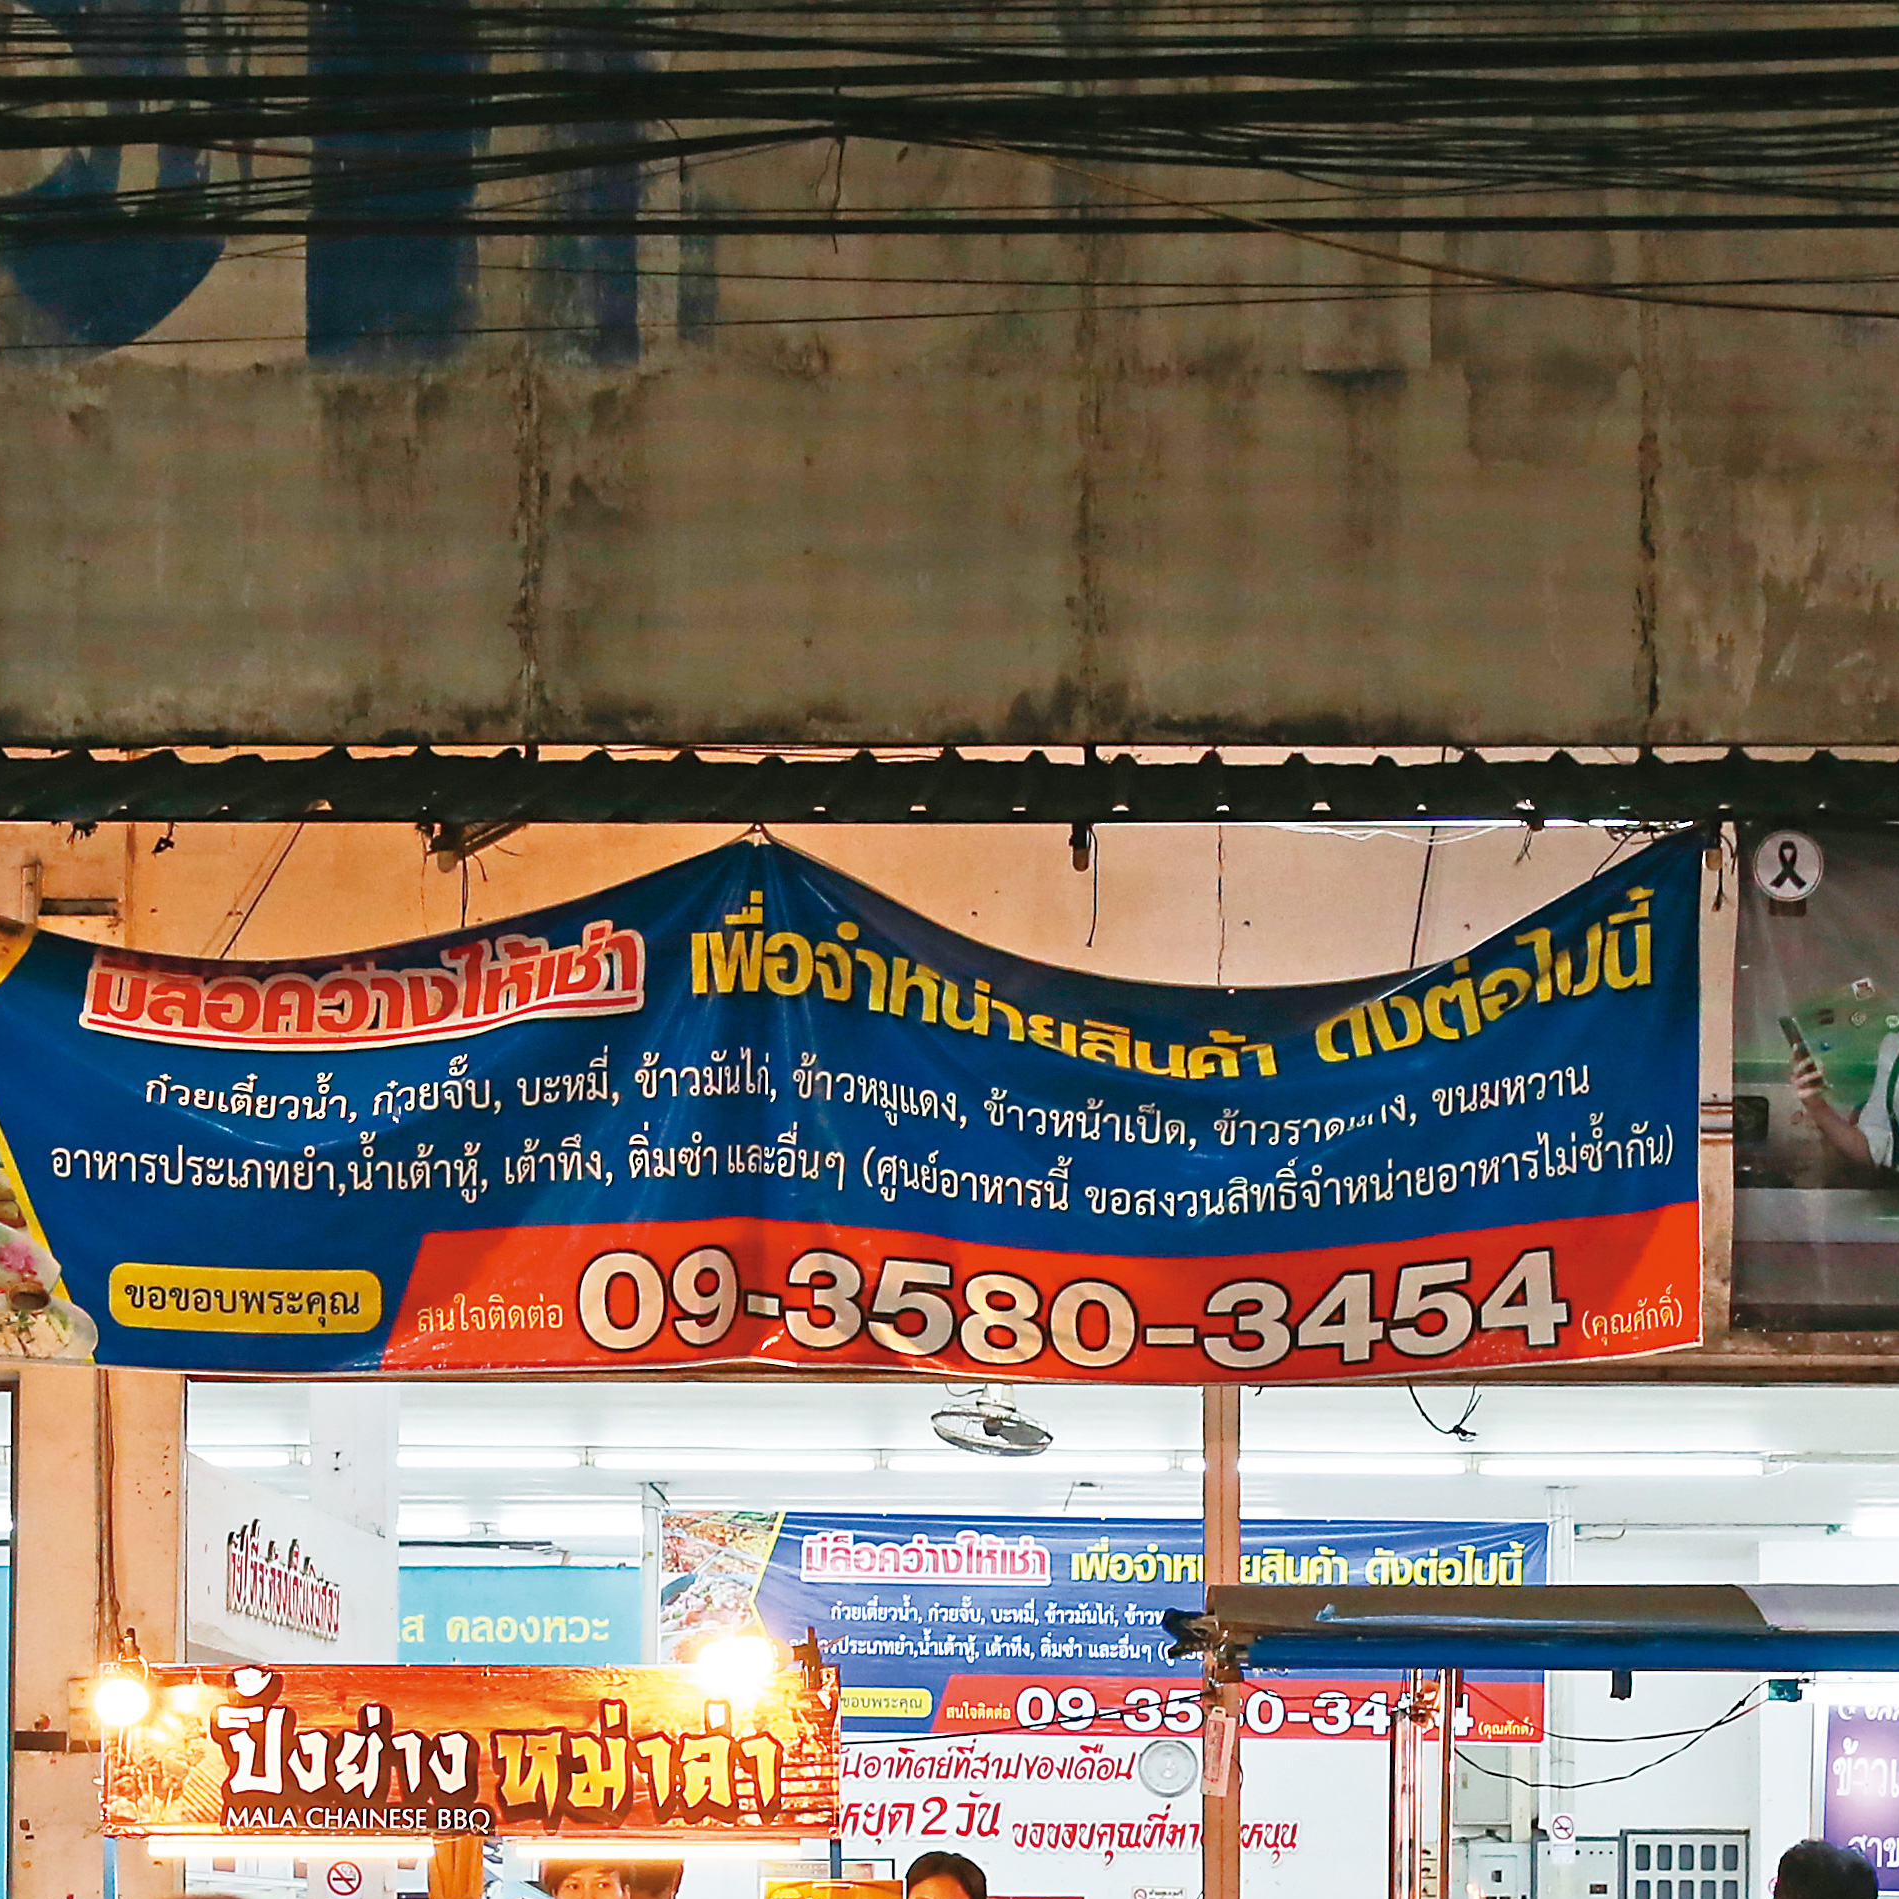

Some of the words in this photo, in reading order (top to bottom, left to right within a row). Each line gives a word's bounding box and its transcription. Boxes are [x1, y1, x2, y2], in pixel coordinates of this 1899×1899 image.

[1432, 1064, 1590, 1118] ขนมหวาน
[628, 1122, 717, 1182] ติ่มซำ
[123, 1270, 361, 1338] ขอขอบพระคุณ
[417, 1291, 564, 1333] สนใจติดต่อ
[579, 1246, 1568, 1370] 09-3580-3454
[804, 1532, 1046, 1575] มีล็อคว่างให้เช่า
[1365, 1541, 1526, 1587] ดังต่อไปนี้
[447, 1613, 610, 1645] คลองหวะ
[217, 1667, 468, 1799] ปิ้งย่าง
[494, 1700, 782, 1817] หม่าล่า
[227, 1808, 297, 1829] MALA
[306, 1808, 427, 1829] CHAINESE
[437, 1808, 491, 1833] BBQ
[921, 1797, 947, 1836] 2
[956, 1791, 1003, 1837] วัน
